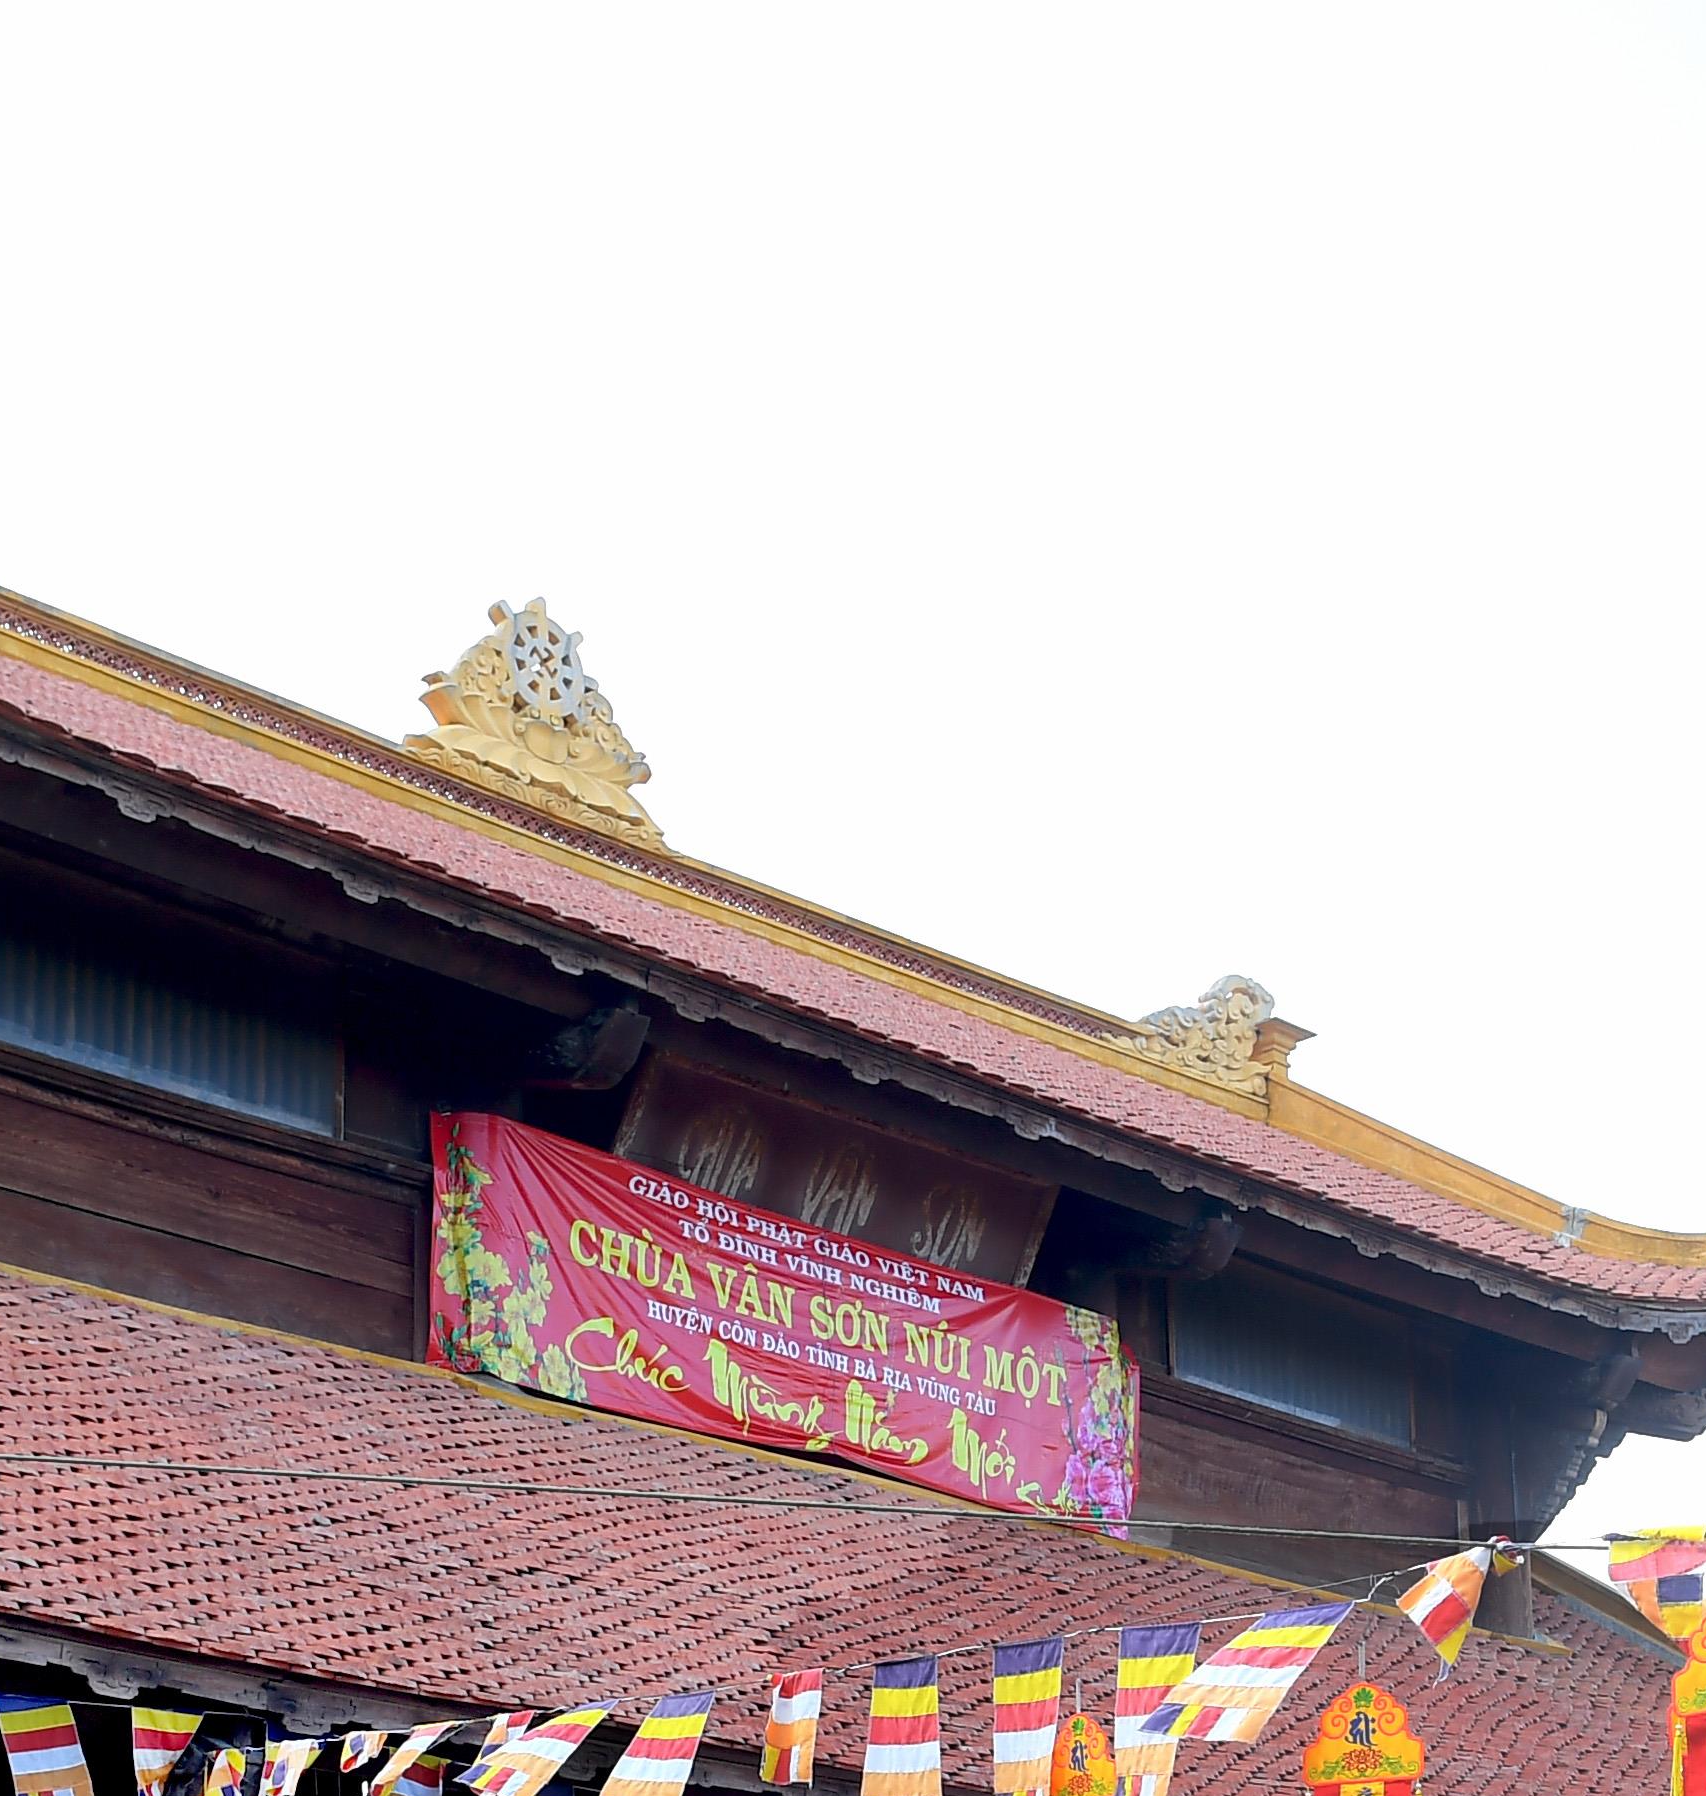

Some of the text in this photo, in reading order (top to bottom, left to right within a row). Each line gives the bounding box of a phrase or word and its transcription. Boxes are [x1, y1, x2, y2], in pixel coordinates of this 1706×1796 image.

[628, 1174, 986, 1303] GIÁO HỘI PHẬT GIÁO VIỆT NAM
[678, 1217, 942, 1314] TỔ ĐÌNH VĨNH NGHIÊM
[569, 1219, 1068, 1408] CHÙA VÂN SƠN NÚI MỘT
[647, 1299, 997, 1416] HUYỆN CÔN ĐẢO TỈNH BÀ RỊA VŨNG TÀU
[565, 1316, 691, 1393] Chúc
[702, 1338, 844, 1452] Mừng
[845, 1378, 929, 1466] Năm
[947, 1406, 1017, 1500] Mới
